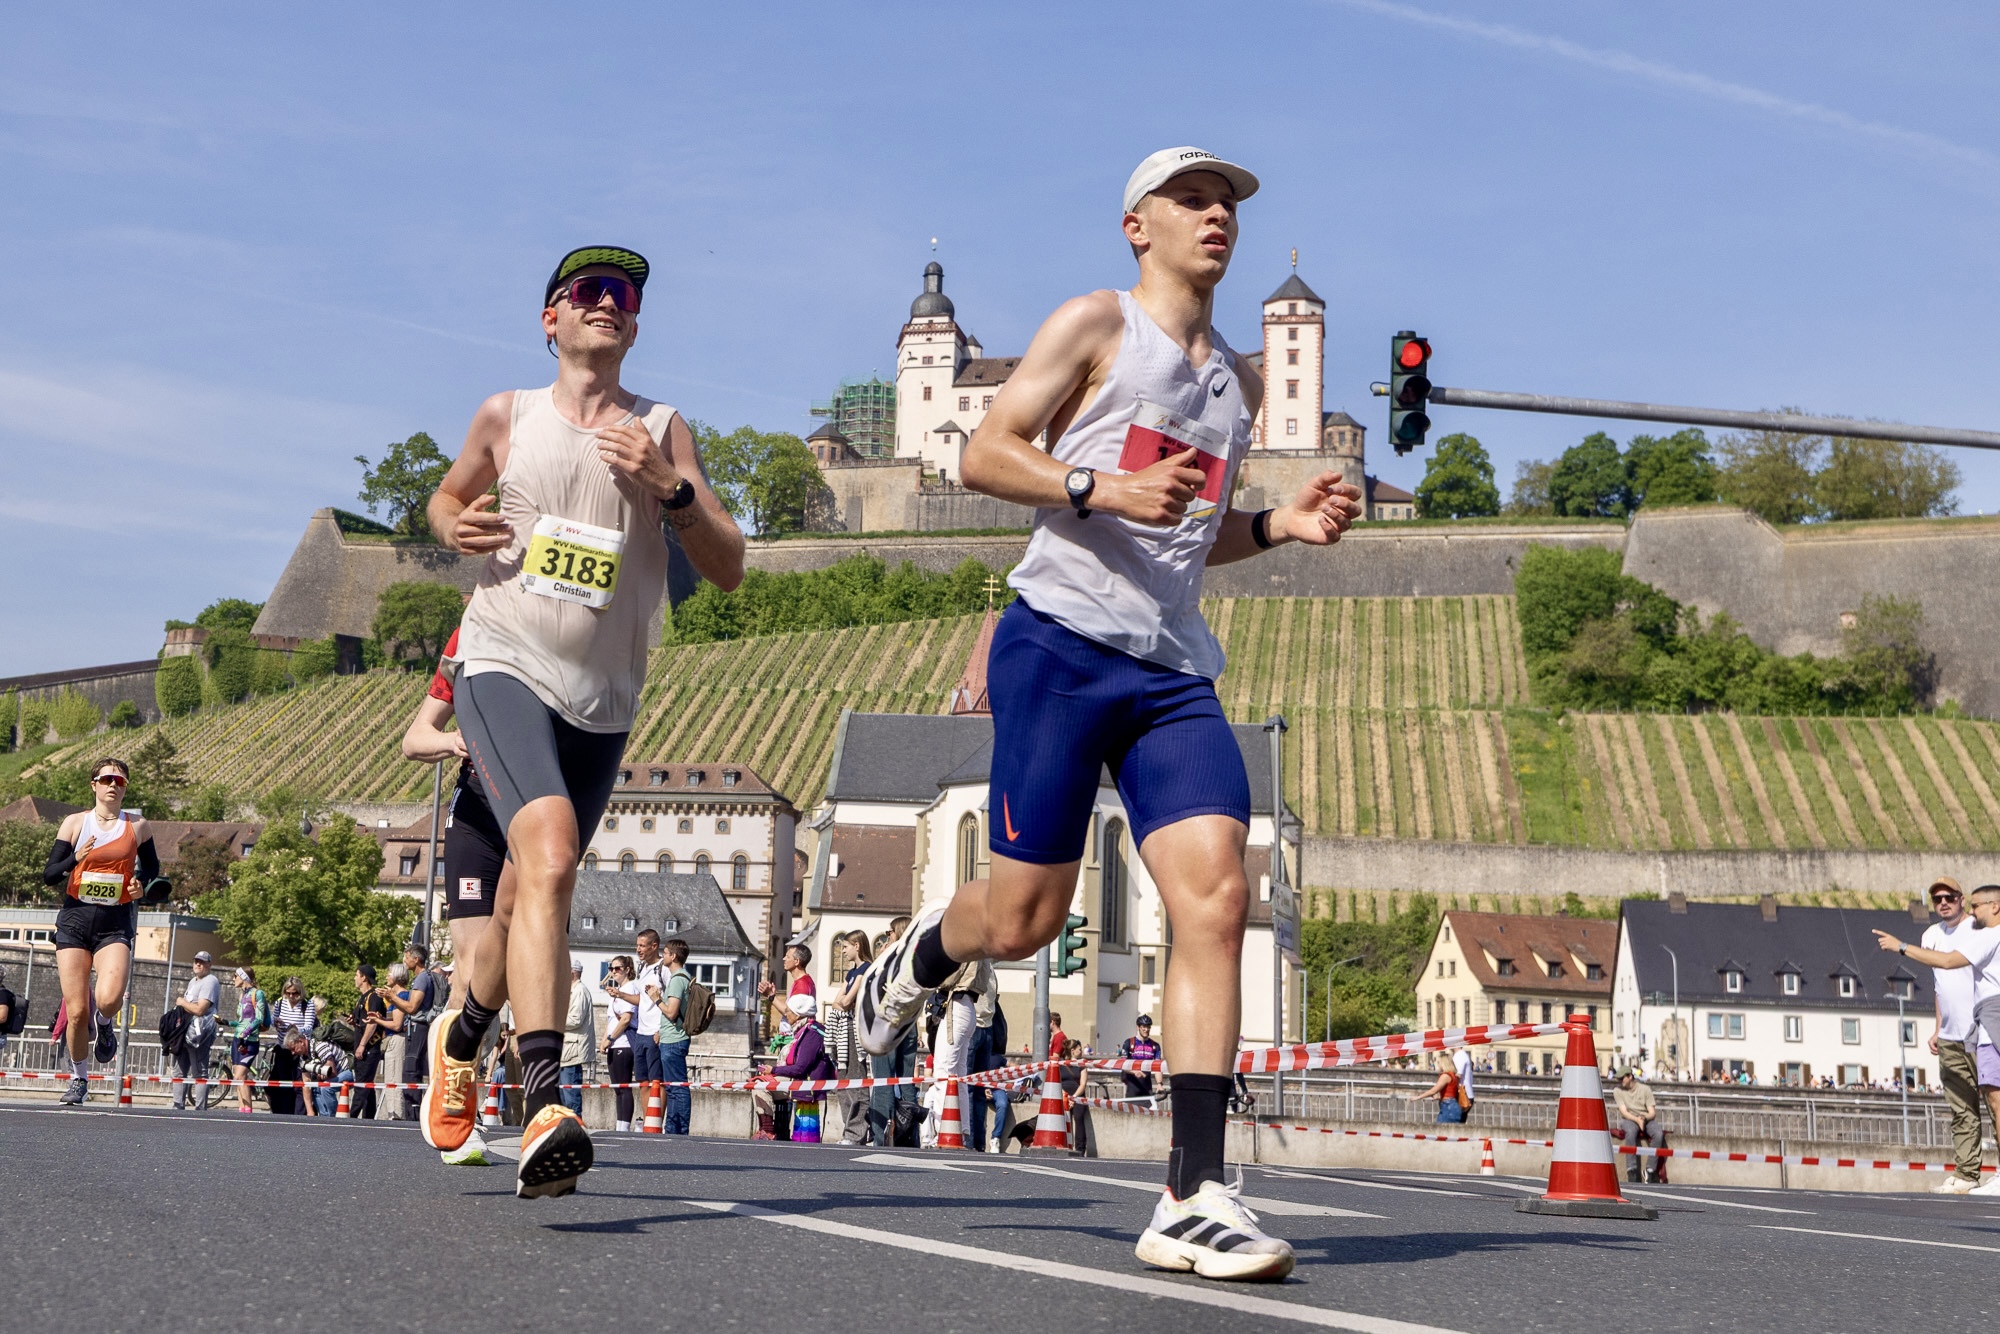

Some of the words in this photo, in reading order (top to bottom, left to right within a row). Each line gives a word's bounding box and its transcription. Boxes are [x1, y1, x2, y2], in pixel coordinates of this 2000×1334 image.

[566, 527, 582, 535] WVV
[553, 540, 569, 548] WVV
[570, 543, 612, 558] Halbmarathon
[540, 547, 615, 589] 3183
[553, 582, 592, 599] Christian
[86, 884, 116, 897] 2928
